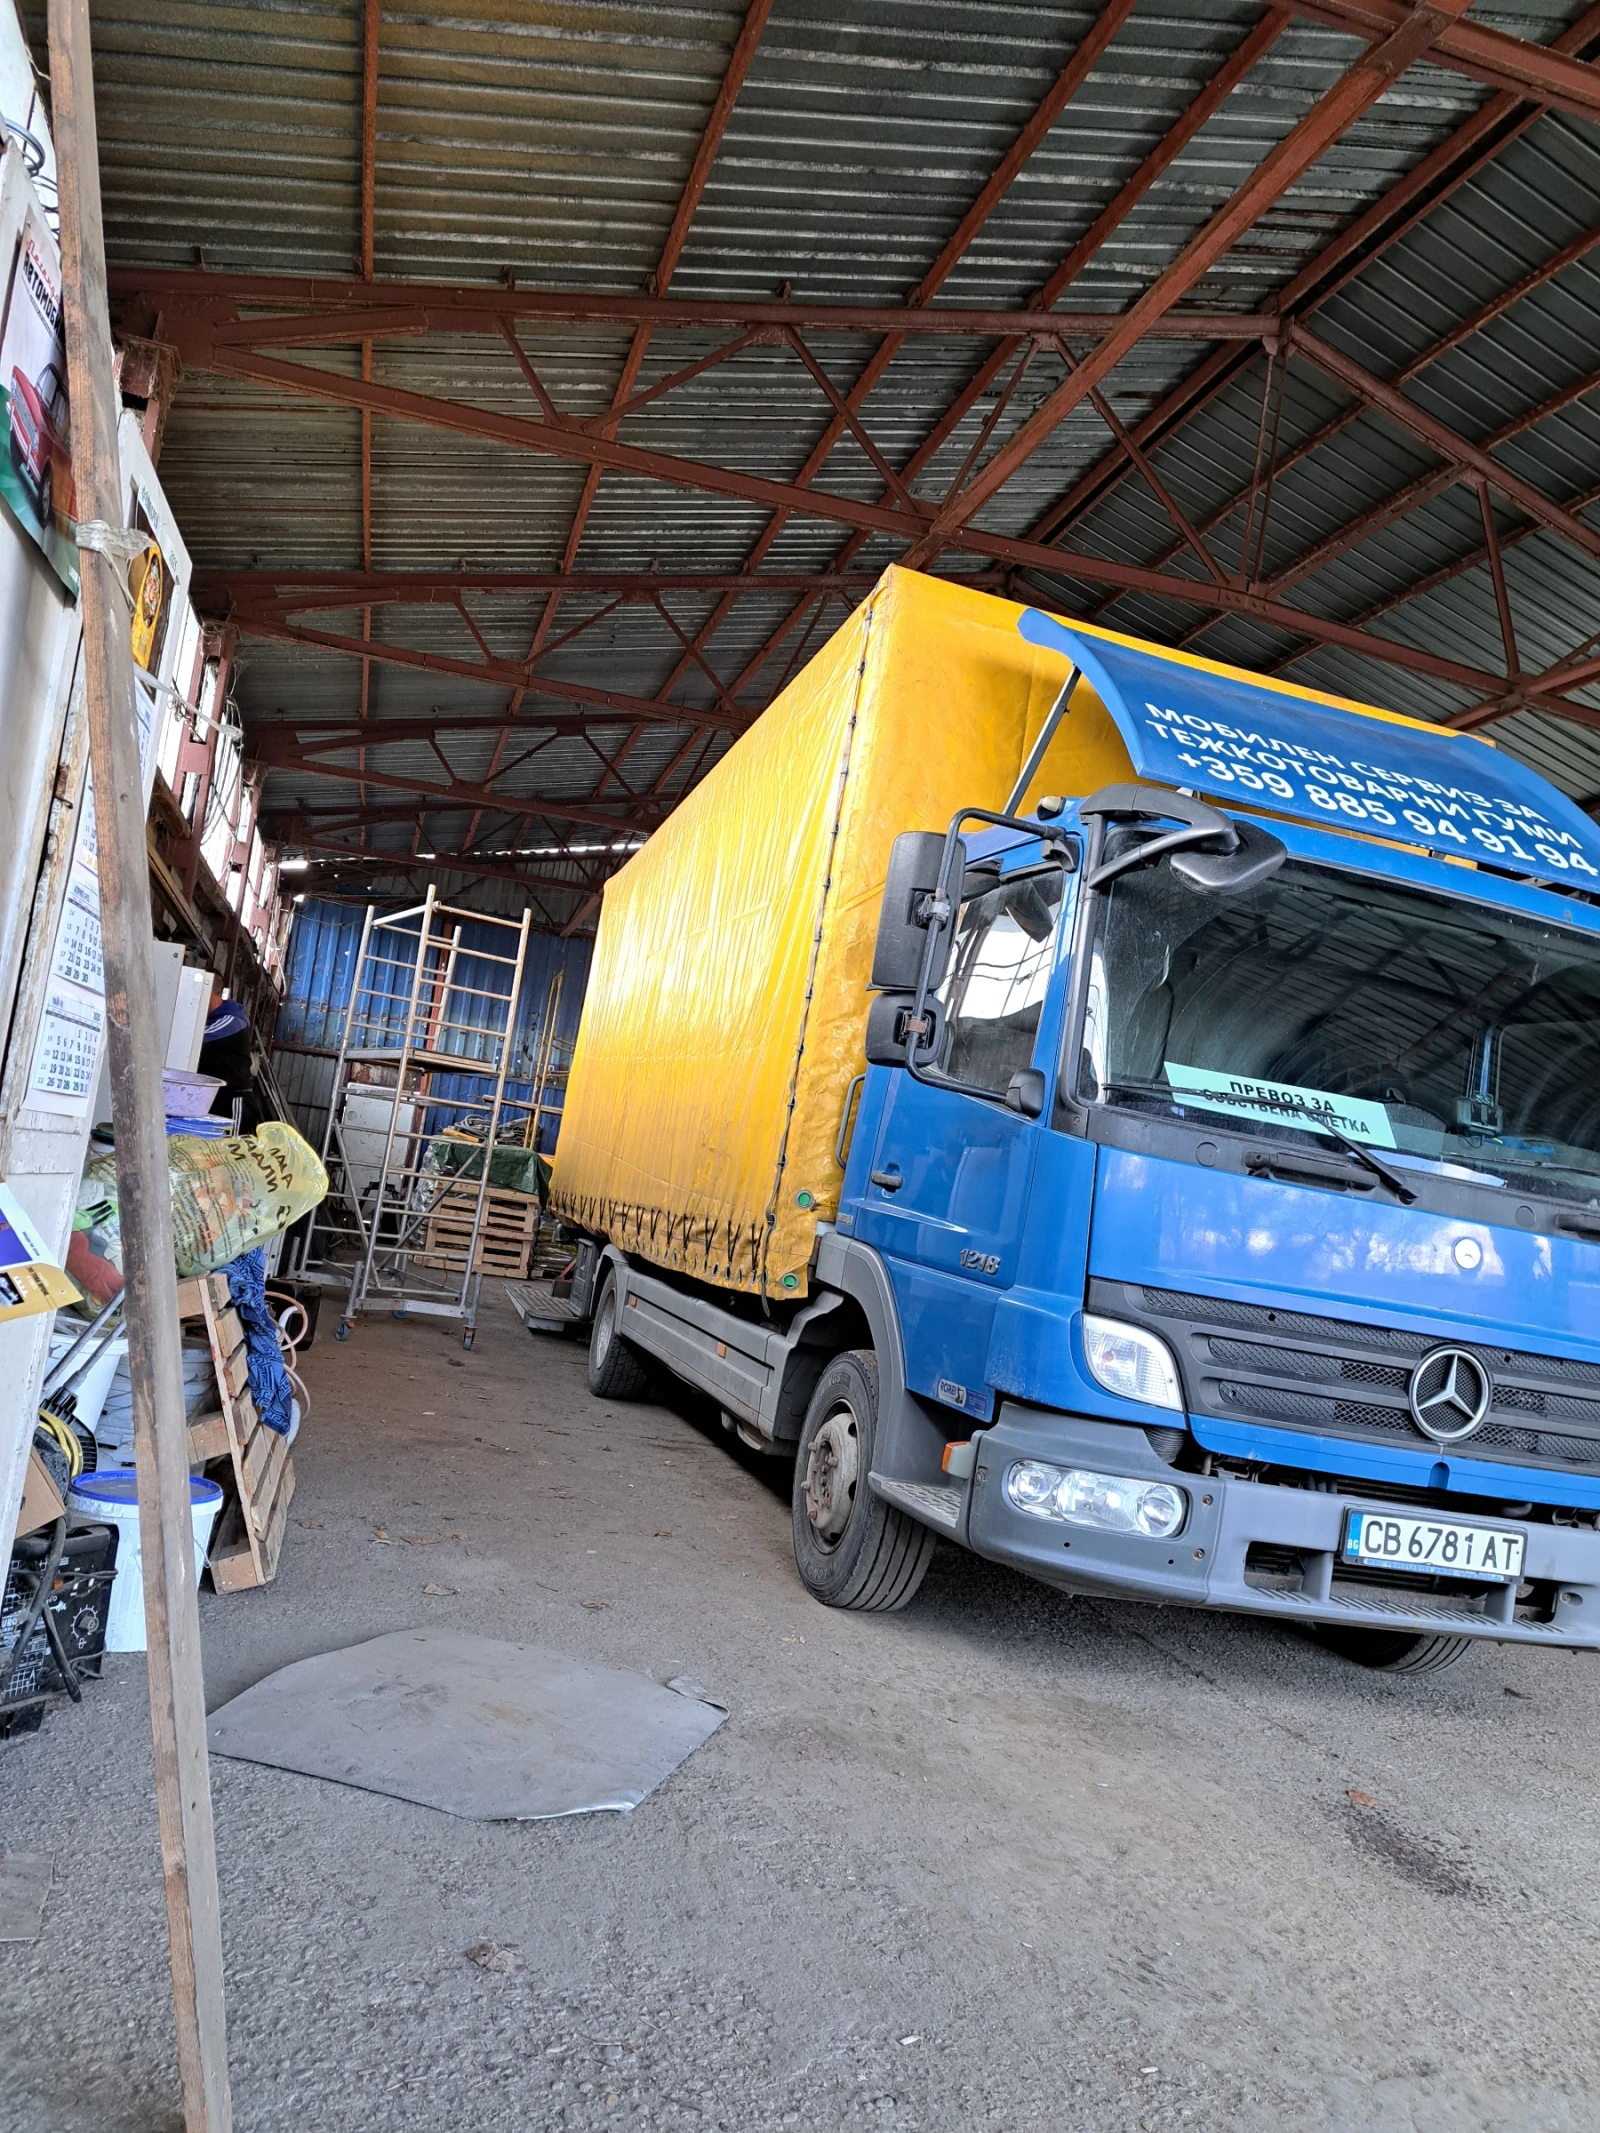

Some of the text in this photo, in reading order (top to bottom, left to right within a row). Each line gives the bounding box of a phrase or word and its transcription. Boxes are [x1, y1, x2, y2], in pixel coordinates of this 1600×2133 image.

[1145, 702, 1550, 823] МОБИЛЕН СЕРВИЗ ЗА
[1145, 719, 1583, 849] ТЕЖКОТОВАРНИ ГУМИ
[1177, 752, 1599, 876] +359 885 94 91 94
[1230, 1081, 1336, 1113] ПРЕВОЗ ЗА
[960, 1248, 1000, 1274] 1218
[1347, 1538, 1359, 1550] BG
[1365, 1520, 1519, 1570] CB 6781 AT
